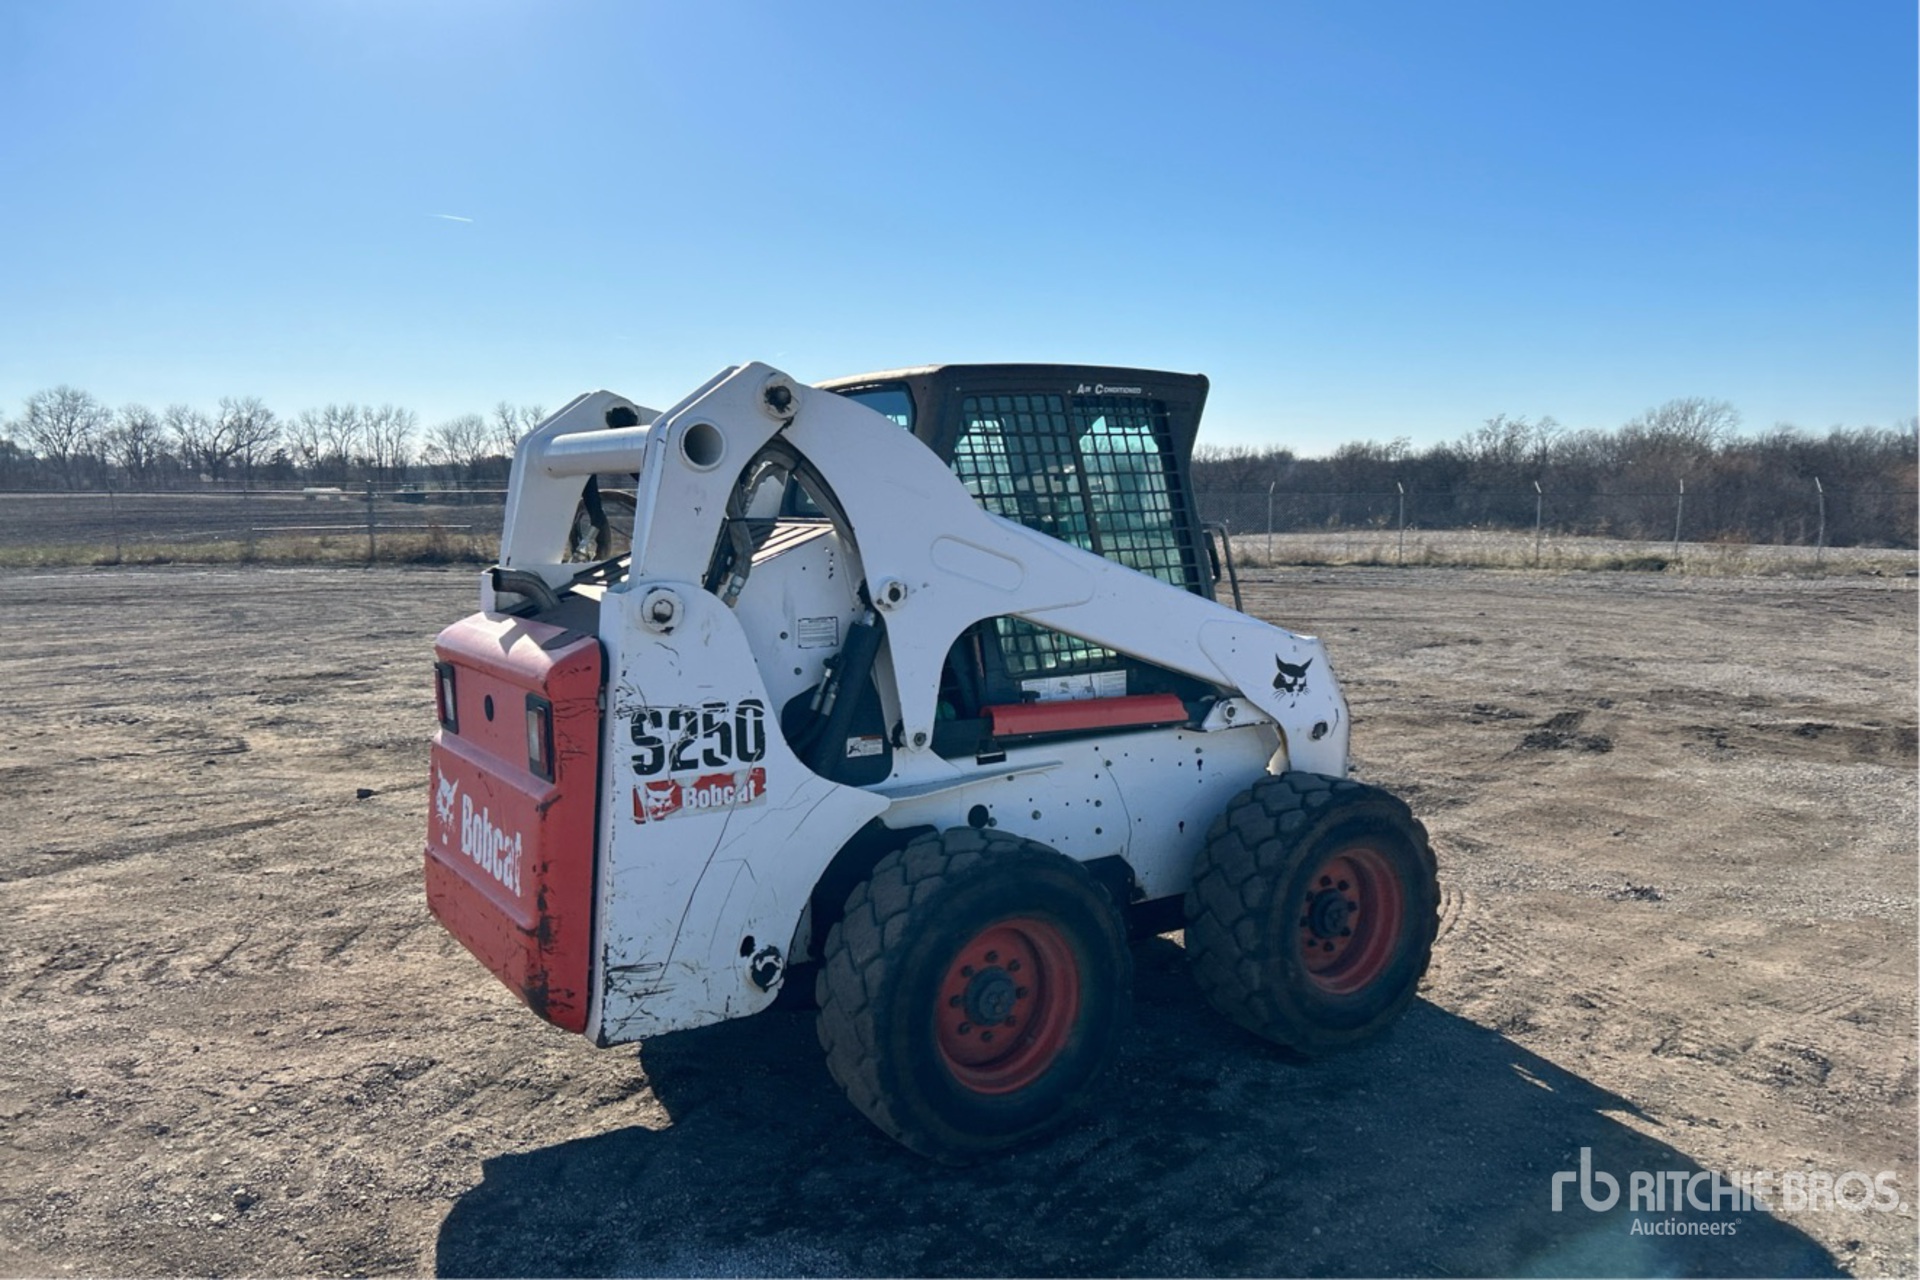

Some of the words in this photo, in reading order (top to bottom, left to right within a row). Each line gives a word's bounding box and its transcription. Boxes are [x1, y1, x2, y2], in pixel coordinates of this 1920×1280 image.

[1094, 383, 1142, 395] CONDITIONED
[630, 698, 767, 776] S250
[681, 779, 757, 810] Bobcat
[461, 793, 523, 898] Bobcat
